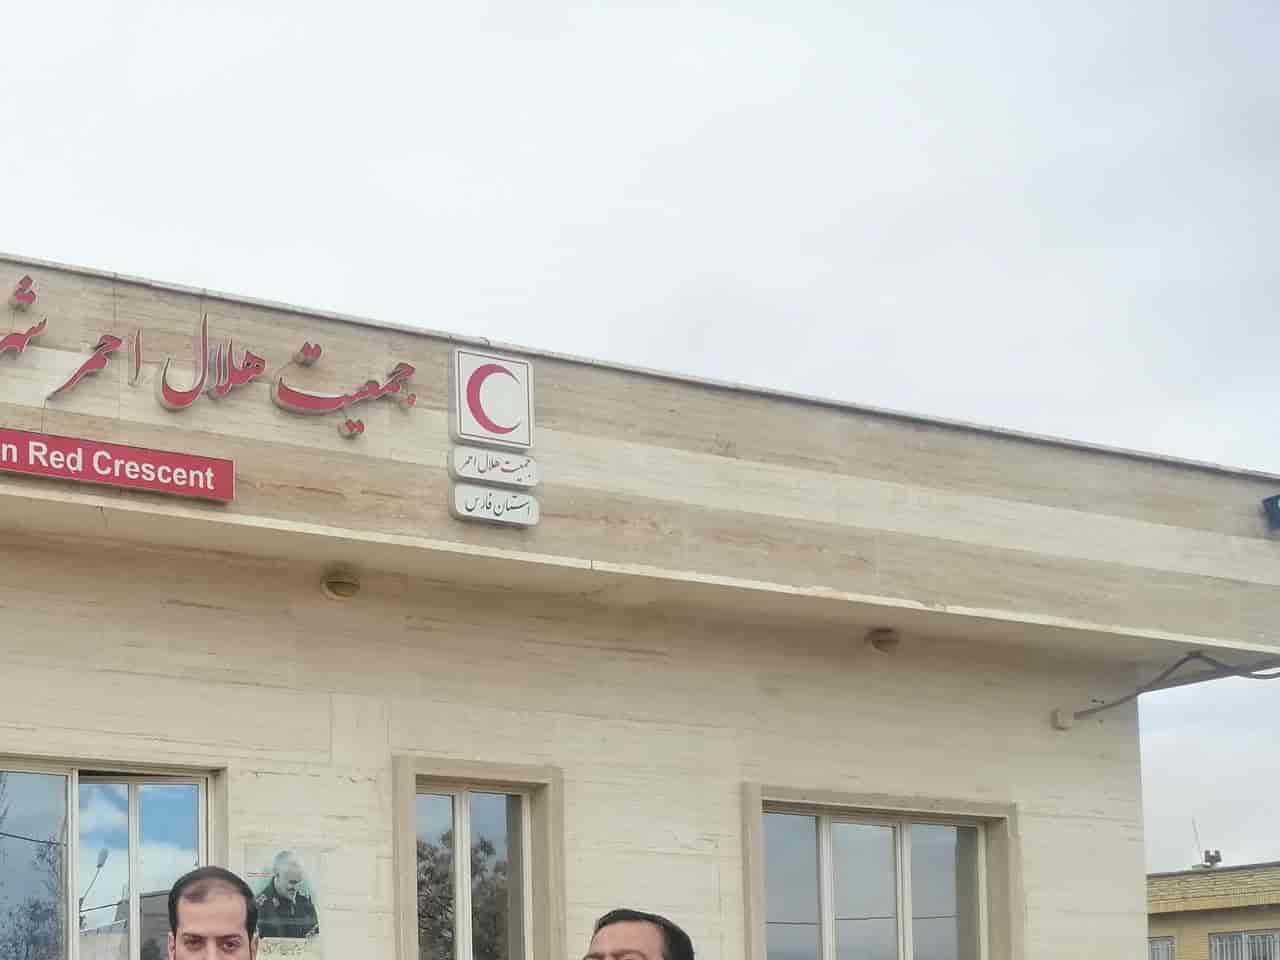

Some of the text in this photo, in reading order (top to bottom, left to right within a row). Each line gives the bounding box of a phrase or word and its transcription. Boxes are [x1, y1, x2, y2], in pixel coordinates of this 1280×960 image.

[46, 327, 144, 400] احمر
[156, 312, 266, 411] هلال
[274, 340, 418, 440] جمعیت
[28, 440, 83, 472] Red
[92, 450, 216, 490] Crescent
